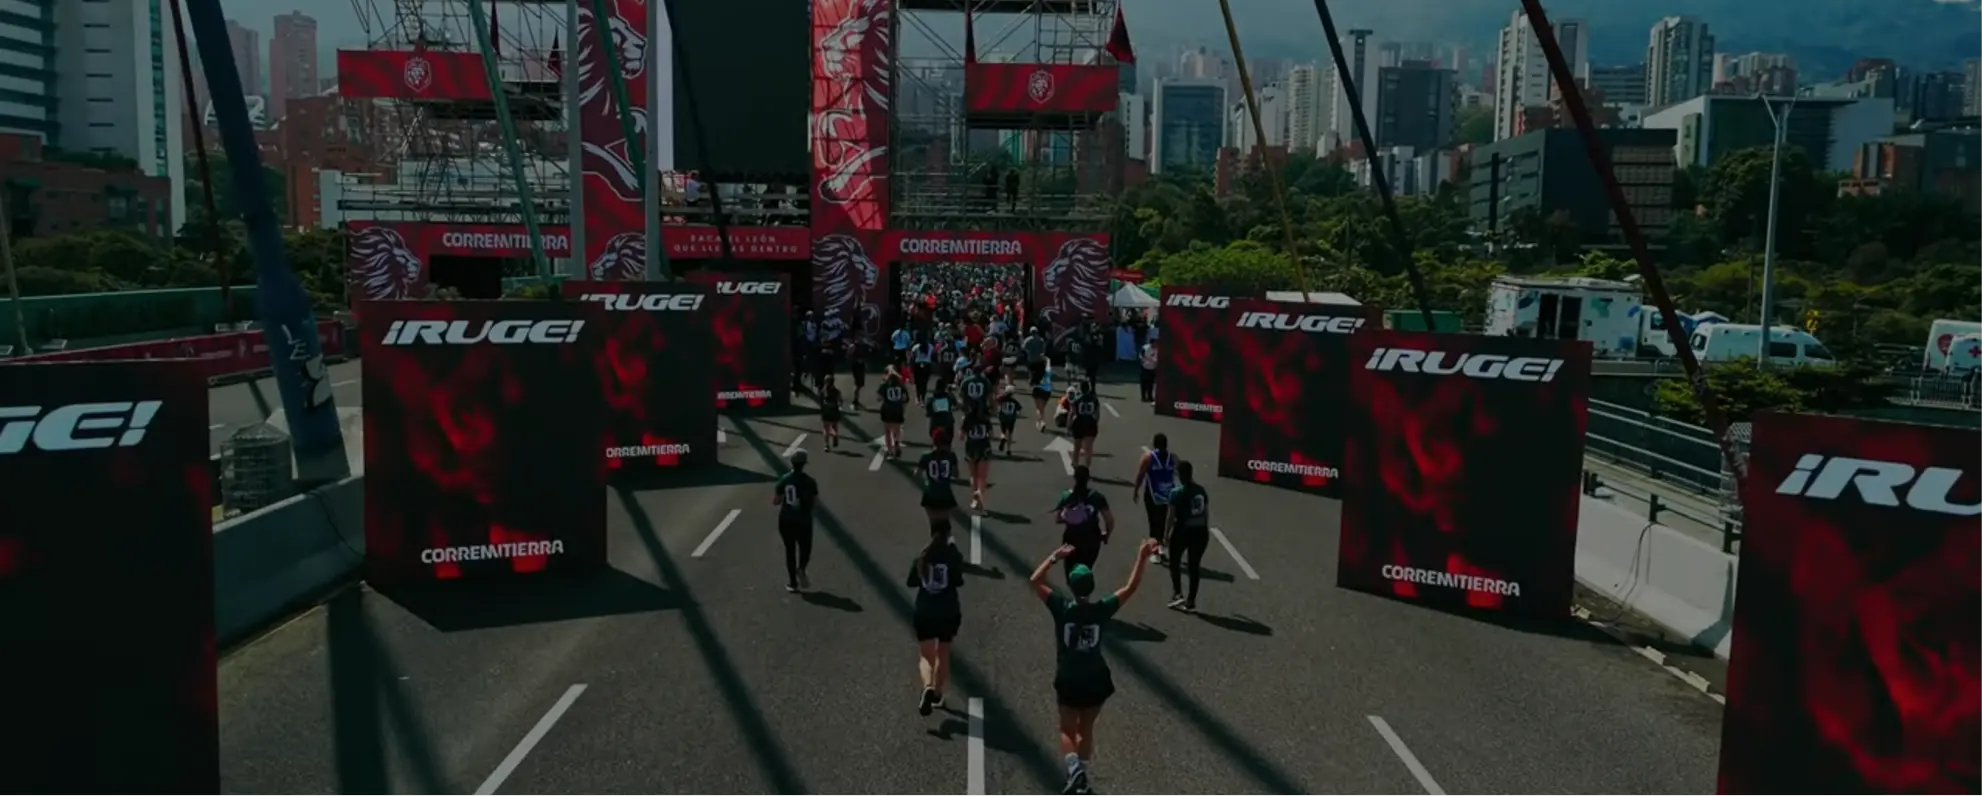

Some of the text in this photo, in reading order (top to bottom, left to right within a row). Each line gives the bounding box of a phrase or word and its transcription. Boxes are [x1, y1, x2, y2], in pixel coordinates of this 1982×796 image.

[701, 244, 745, 252] LLEAS
[899, 238, 1022, 256] CORREMITIERRA
[1247, 460, 1339, 479] CORREMITIERRA
[421, 539, 564, 564] CORREMITIERRA
[1382, 564, 1520, 597] CORREMITIERRA
